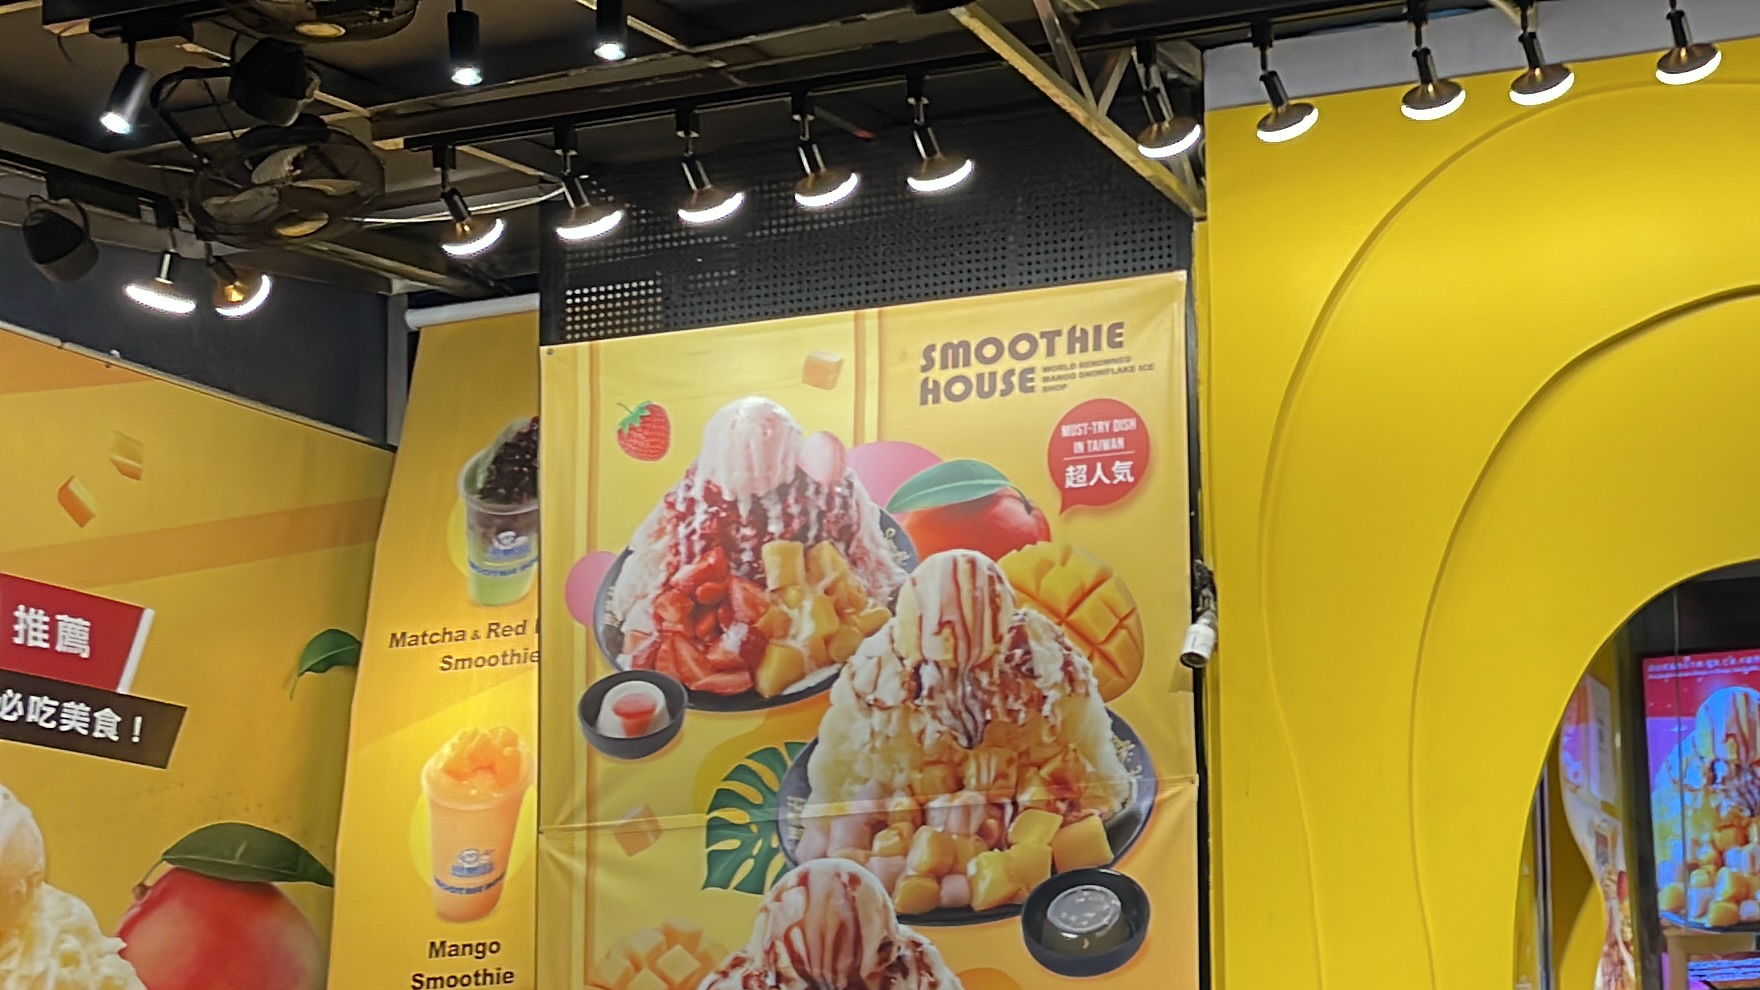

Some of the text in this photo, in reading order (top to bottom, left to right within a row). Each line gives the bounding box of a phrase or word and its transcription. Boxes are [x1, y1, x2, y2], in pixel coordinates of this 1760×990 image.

[920, 321, 1125, 373] SMOOTHIE
[919, 366, 1036, 406] HOUSE
[1061, 417, 1137, 438] MUST-TRY DISH
[1073, 437, 1125, 454] IN TAIWAN
[1064, 460, 1135, 489] 超人気
[13, 604, 91, 659] 推薦
[388, 619, 528, 649] Matcha & Red
[439, 647, 540, 672] Smoothie
[428, 940, 501, 960] Mango
[411, 967, 516, 990] Smoothie
